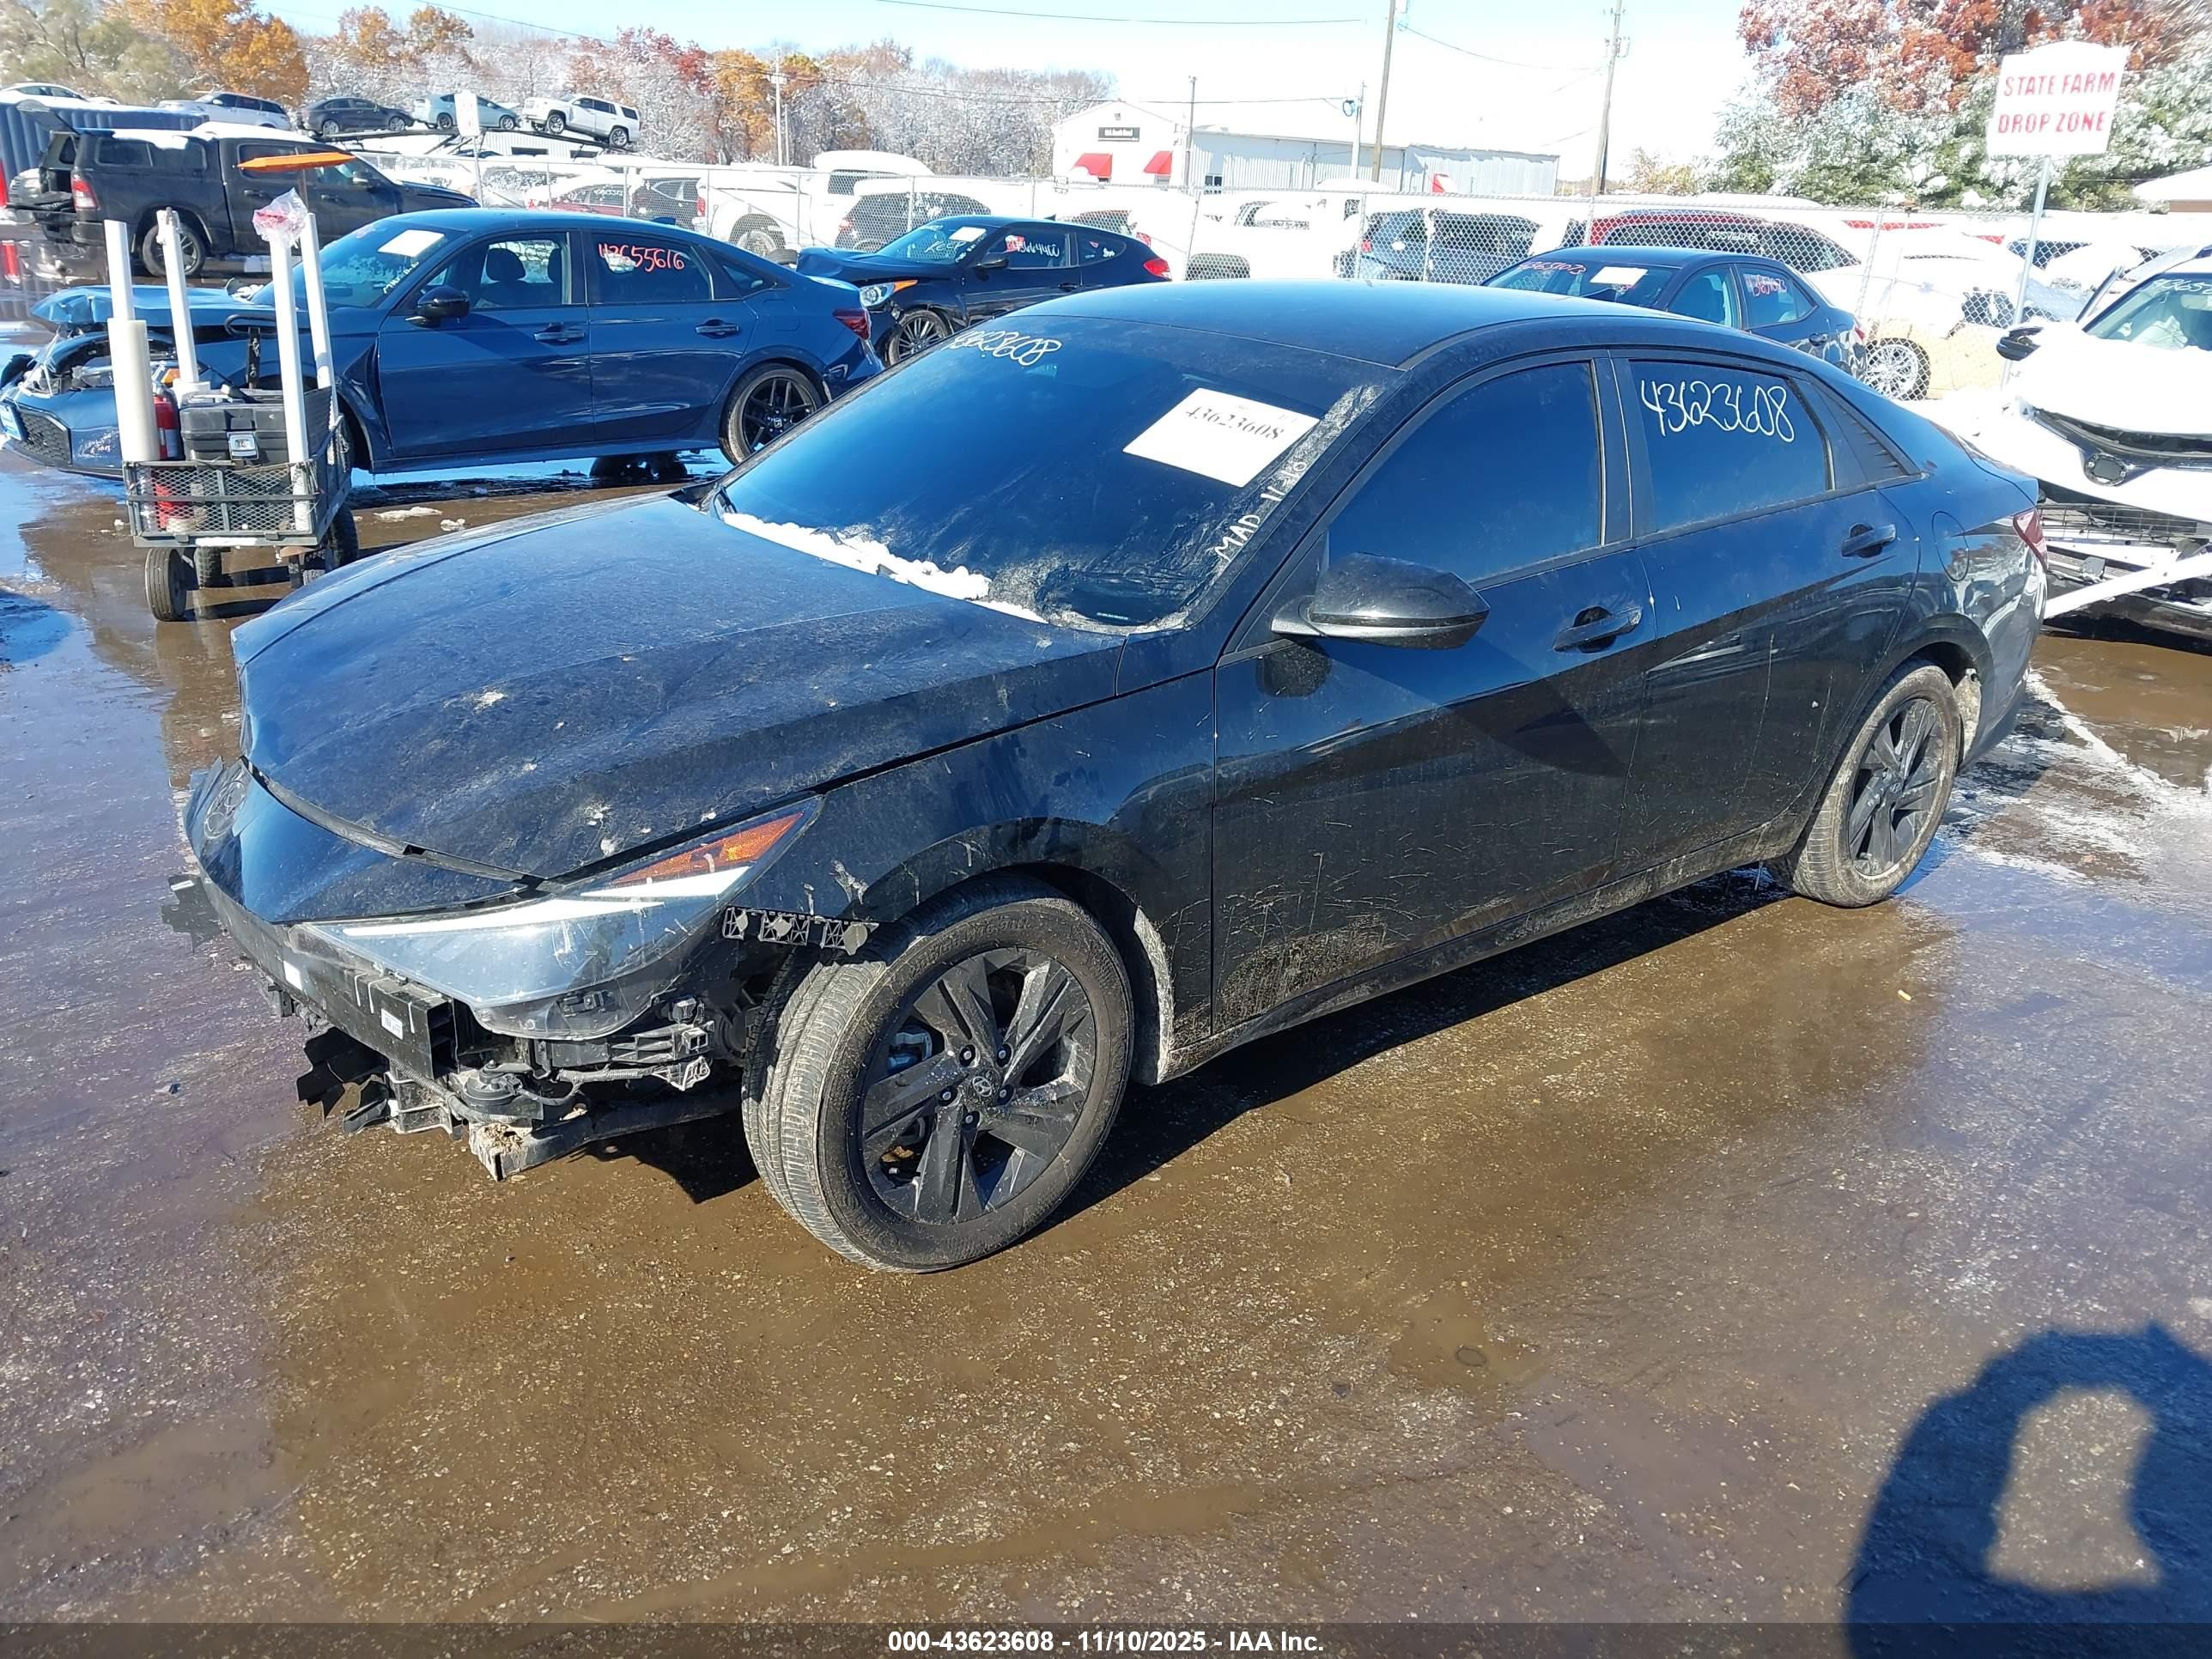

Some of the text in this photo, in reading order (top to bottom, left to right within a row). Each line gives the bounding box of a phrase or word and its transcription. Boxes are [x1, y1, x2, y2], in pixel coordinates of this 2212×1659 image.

[2004, 71, 2115, 96] STATE FARM
[1998, 111, 2106, 133] DROP ZONE
[1186, 405, 1285, 441] 43623608
[1641, 380, 1795, 442] 43623608
[1214, 514, 1261, 562] MAD
